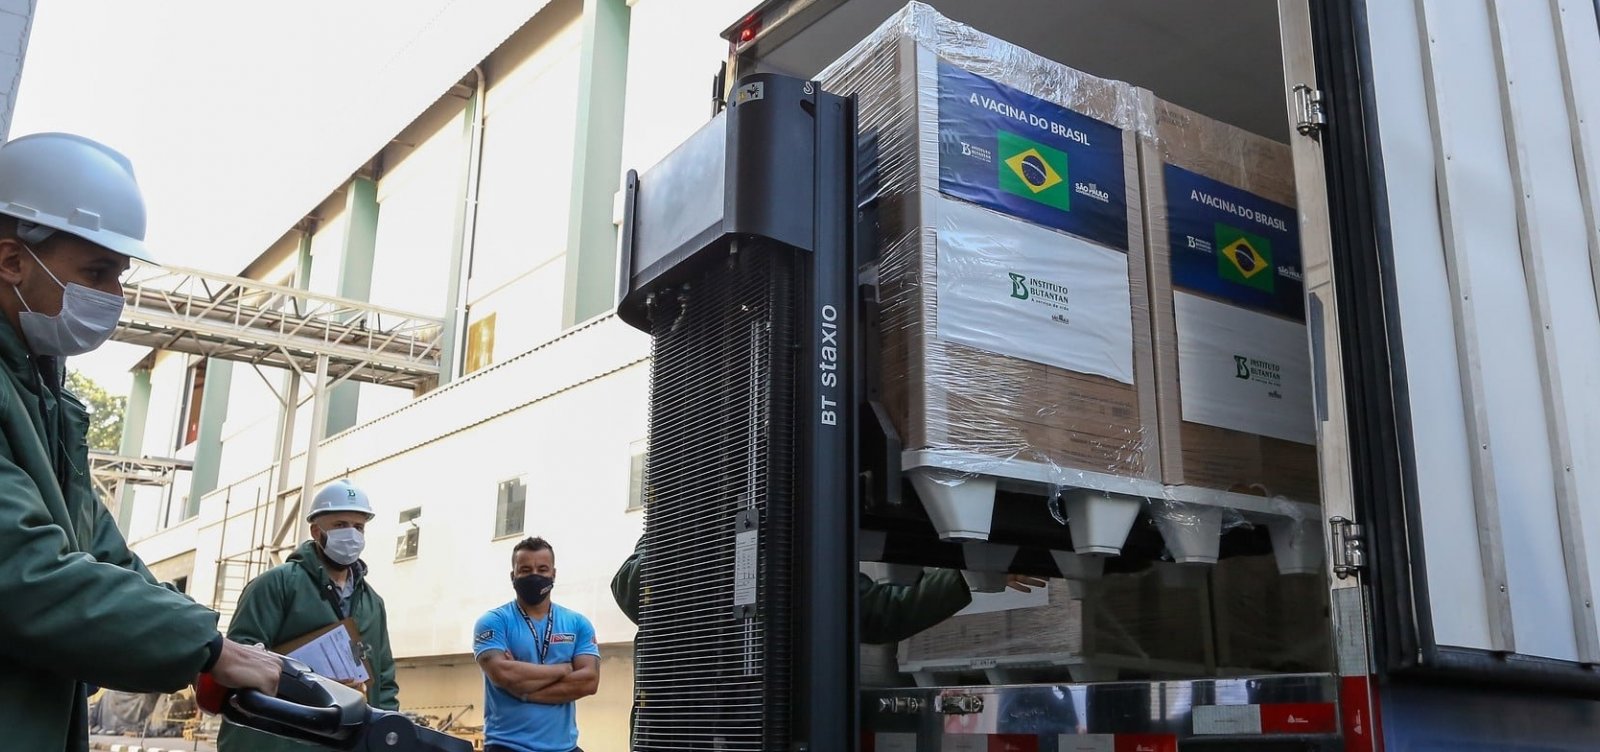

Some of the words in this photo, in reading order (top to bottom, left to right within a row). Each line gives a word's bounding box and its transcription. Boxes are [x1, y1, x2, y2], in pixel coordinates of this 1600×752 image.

[968, 92, 980, 105] A
[980, 95, 1028, 123] VACINA
[1029, 113, 1049, 130] DO
[1050, 123, 1091, 146] BRASIL
[1190, 189, 1199, 202] A
[1199, 191, 1237, 215] VACINA
[1238, 205, 1254, 220] DO
[1255, 211, 1287, 231] BRASIL
[1030, 278, 1069, 295] INSTITUTO
[1030, 287, 1069, 304] BUTANTAN
[819, 304, 838, 388] staxio
[821, 395, 837, 426] BT
